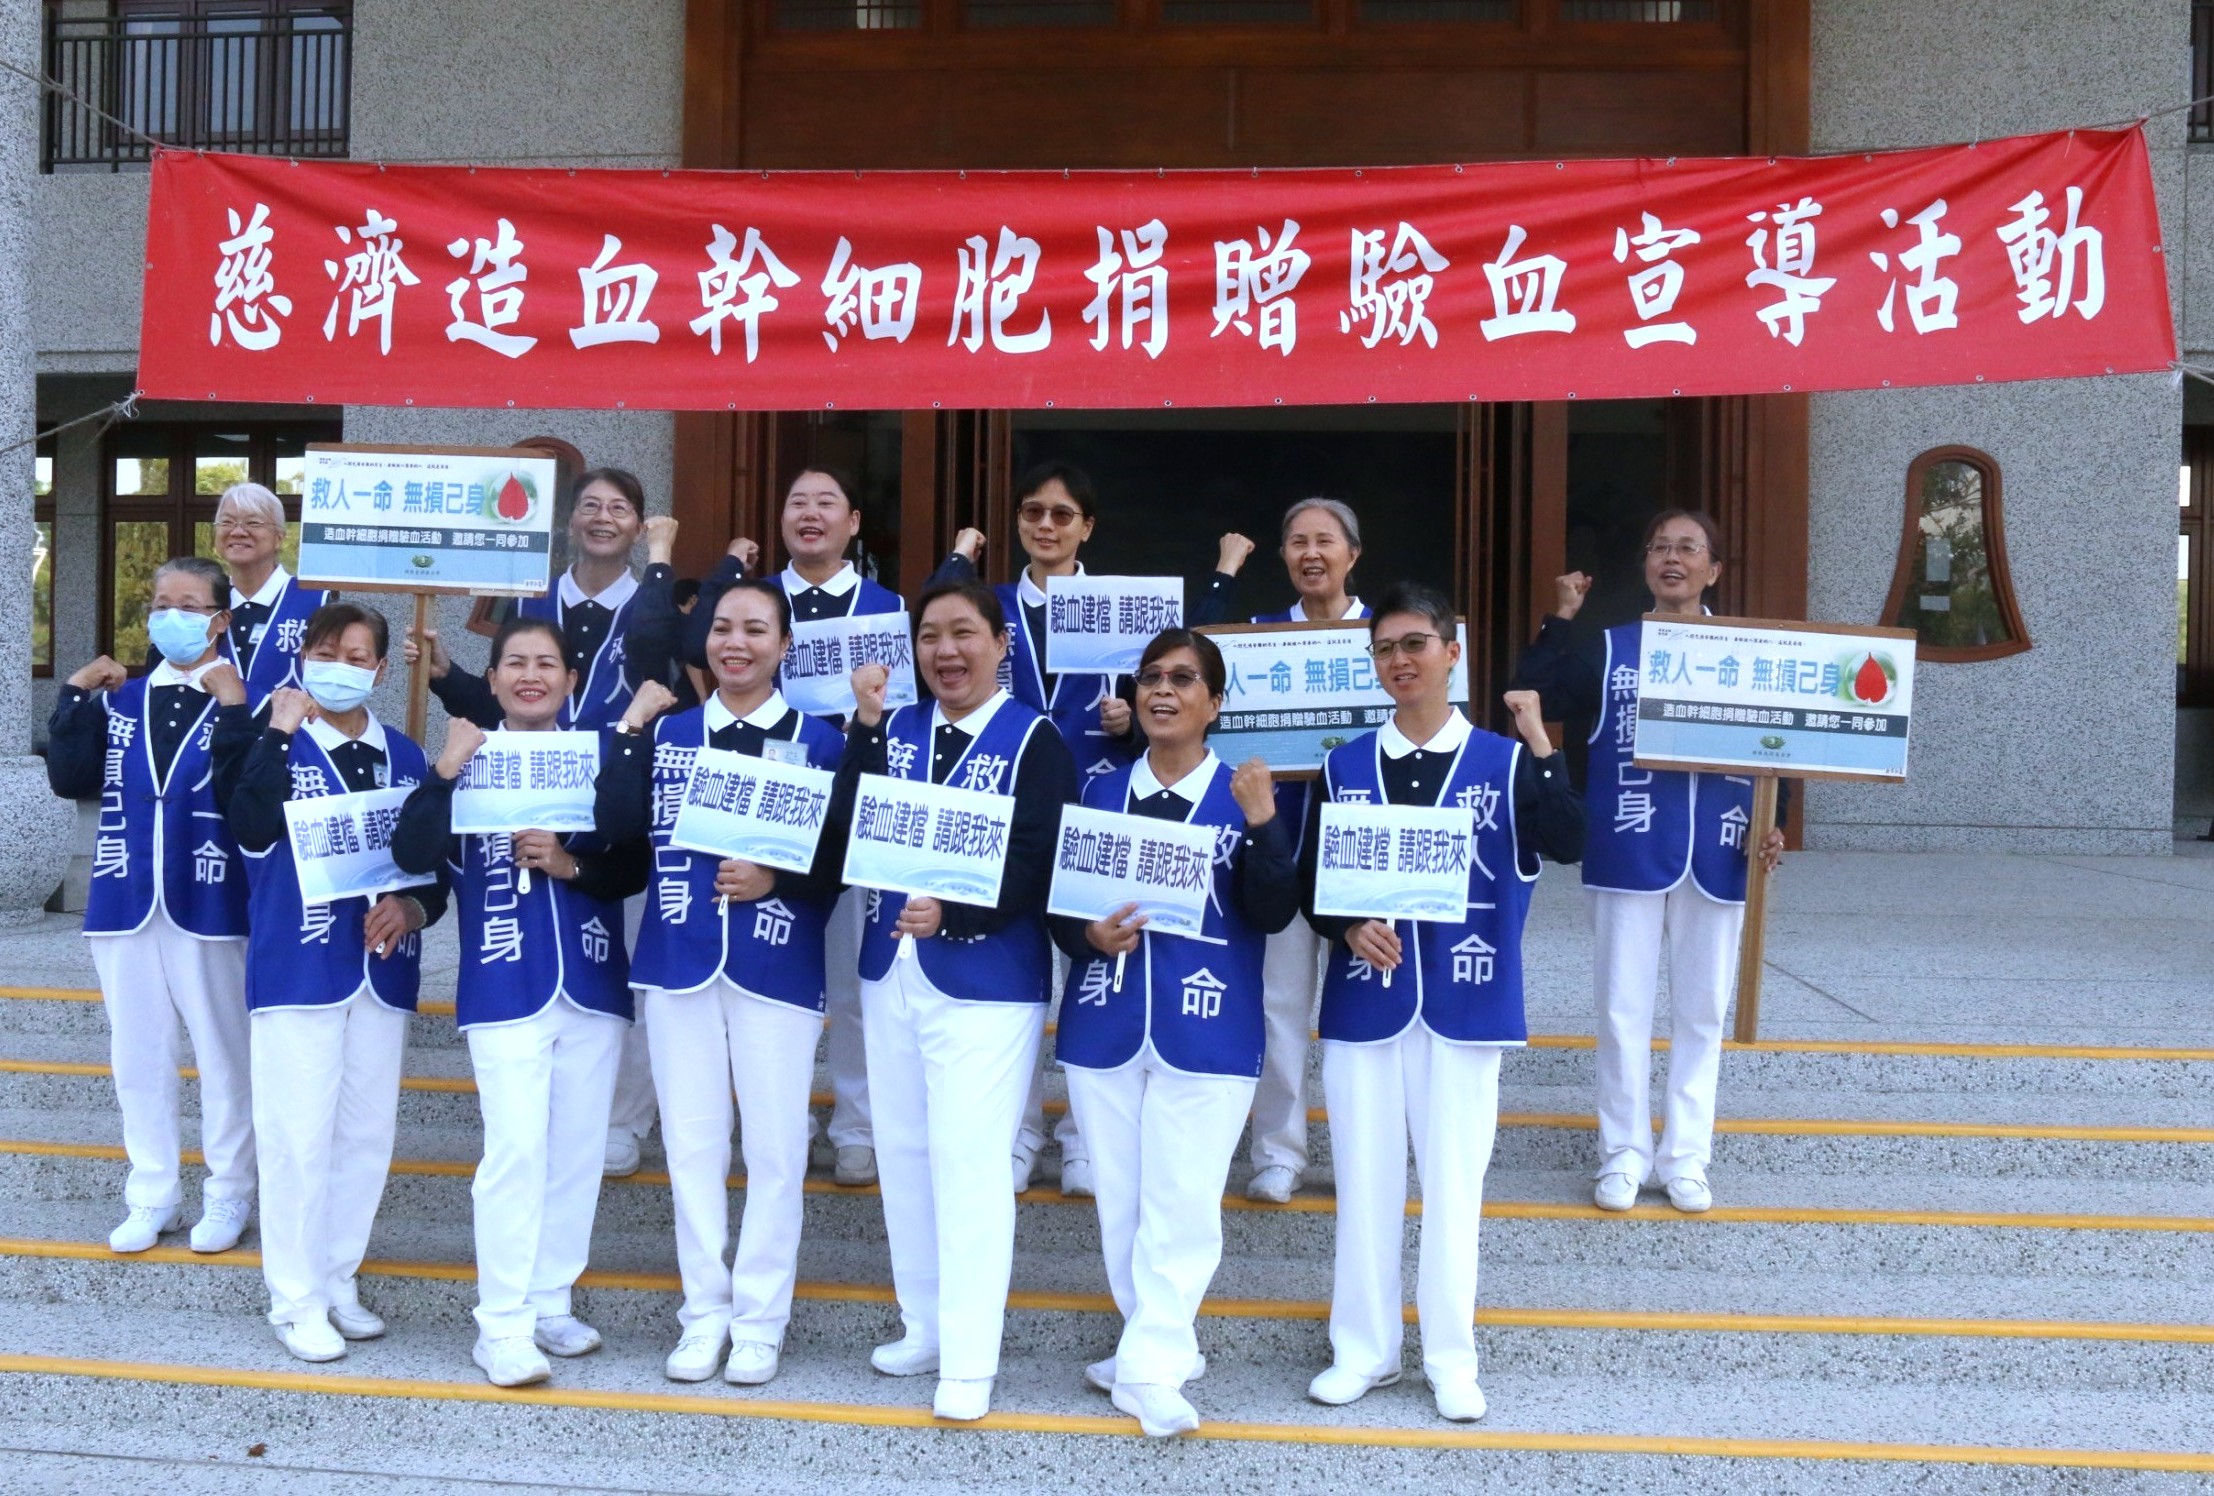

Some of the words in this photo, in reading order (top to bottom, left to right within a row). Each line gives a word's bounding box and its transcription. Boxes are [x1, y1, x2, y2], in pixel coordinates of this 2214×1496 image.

[210, 186, 2107, 363] 慈濟造血幹細胞捐贈驗血宣導活動
[311, 477, 393, 512] 救人一命
[403, 481, 485, 516] 無損己身
[324, 527, 442, 545] 造血幹細胞捐贈驗血活動
[452, 532, 529, 548] 邀請您一同參加
[1051, 594, 1112, 634] 驗血建檔
[1118, 594, 1180, 635] 請跟我來
[1304, 657, 1384, 694] 無損己
[1648, 650, 1740, 689] 救人一命
[1751, 656, 1842, 697] 無損己身
[1219, 710, 1353, 730] 造血幹細胞捐贈驗血活動
[1662, 703, 1794, 726] 造血幹細胞捐贈驗血活動
[1804, 712, 1888, 732] 邀請您一同參加
[530, 750, 596, 790] 請跟我來
[686, 766, 757, 817] 驗血建檔
[756, 779, 827, 830] 請跟我來
[293, 811, 361, 861] 驗血建檔
[856, 795, 930, 849] 驗血建檔
[932, 807, 1007, 862] 請跟我來
[1322, 824, 1391, 872] 驗血建檔
[1397, 827, 1468, 875] 請跟我來
[1058, 826, 1132, 880] 驗血建檔
[1135, 838, 1209, 893] 請跟我來
[580, 916, 610, 964] 命
[753, 897, 797, 946] 命
